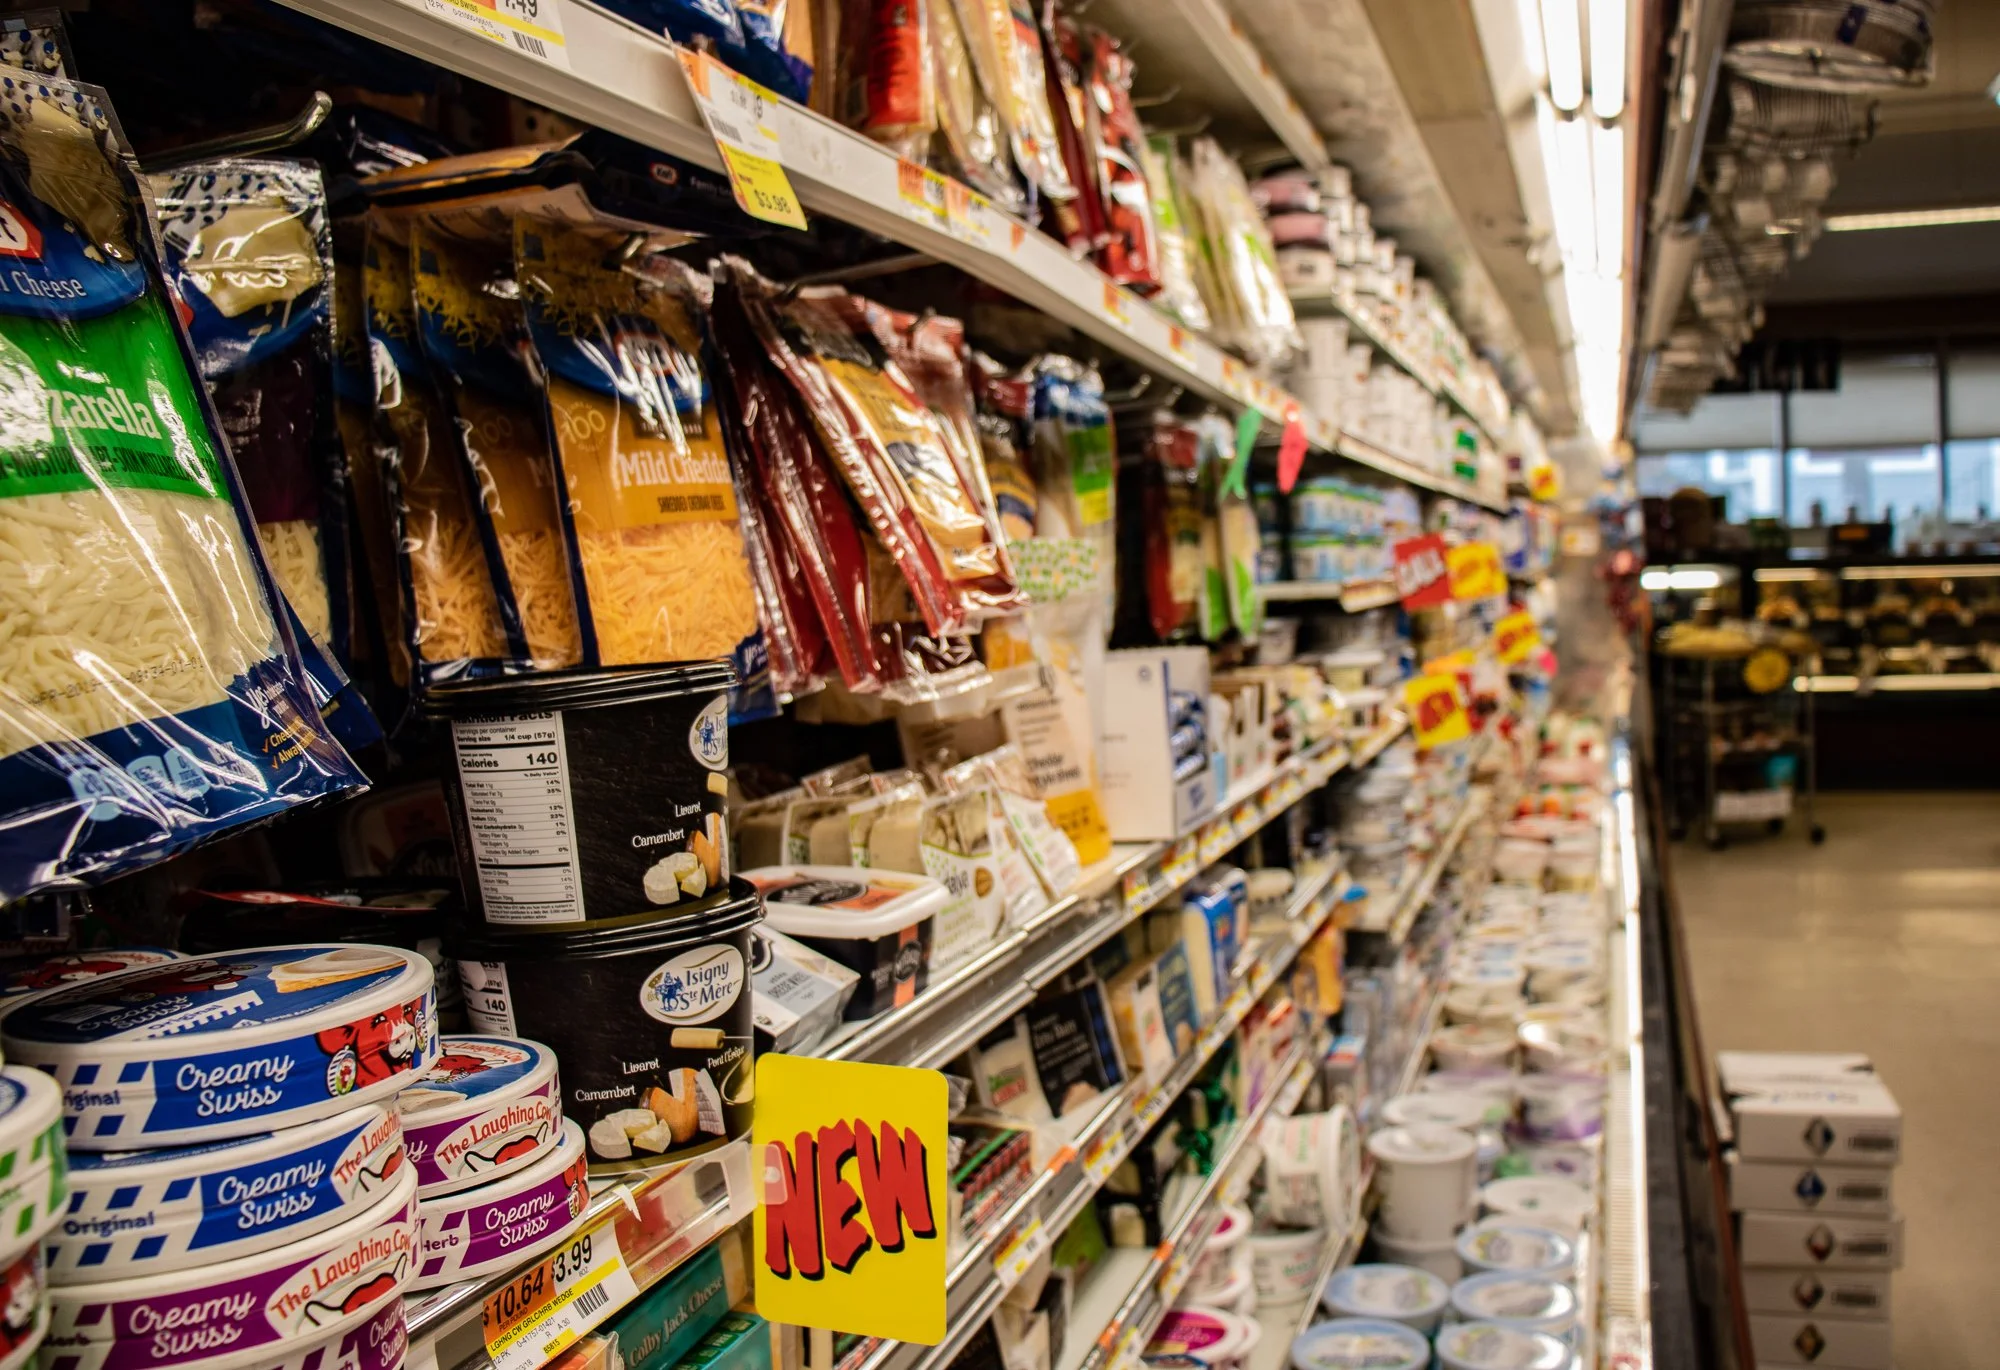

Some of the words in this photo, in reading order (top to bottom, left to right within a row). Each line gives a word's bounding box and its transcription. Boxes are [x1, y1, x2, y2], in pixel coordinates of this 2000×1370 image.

[11, 270, 88, 299] Cheese
[46, 386, 163, 439] zarella
[618, 452, 671, 487] Mild
[672, 450, 732, 485] Chedda
[504, 734, 516, 742] 1/4
[534, 731, 556, 740] (57g)
[461, 758, 500, 769] Calories
[526, 751, 558, 765] 140
[675, 801, 702, 818] Livarot
[632, 828, 686, 848] Camembert
[686, 961, 730, 987] Isigny
[485, 998, 506, 1012] 140
[699, 981, 733, 1005] Mère
[176, 1054, 294, 1091] Creamy
[622, 1057, 661, 1075] Livarot
[63, 1090, 121, 1111] riginal
[197, 1083, 283, 1117] Swiss
[575, 1084, 637, 1102] Camembert
[437, 1137, 471, 1165] The
[469, 1105, 534, 1145] Laughing
[218, 1159, 326, 1205] Creamy
[334, 1151, 362, 1185] The
[237, 1191, 316, 1229] Swiss
[485, 1191, 555, 1230] Creamy
[765, 1117, 937, 1282] NEW
[63, 1211, 155, 1238] Original
[500, 1215, 549, 1248] Swiss
[270, 1284, 312, 1320] The
[311, 1237, 391, 1292] Laughing
[393, 1229, 411, 1252] Cow
[483, 1266, 545, 1327] $10.64
[551, 1234, 592, 1282] $3.99
[129, 1291, 257, 1334] Creamy
[490, 1332, 513, 1353] LGHNG
[512, 1324, 523, 1336] CW
[522, 1303, 553, 1330] GRLC/HRB
[552, 1287, 575, 1308] WEDGE
[499, 1321, 511, 1332] PER
[510, 1307, 529, 1323] POUND
[563, 1318, 571, 1327] 30
[630, 1329, 662, 1367] Colby
[663, 1305, 690, 1345] Jack
[689, 1275, 724, 1314] Cheese
[151, 1322, 243, 1359] Swiss
[500, 1350, 512, 1361] PK
